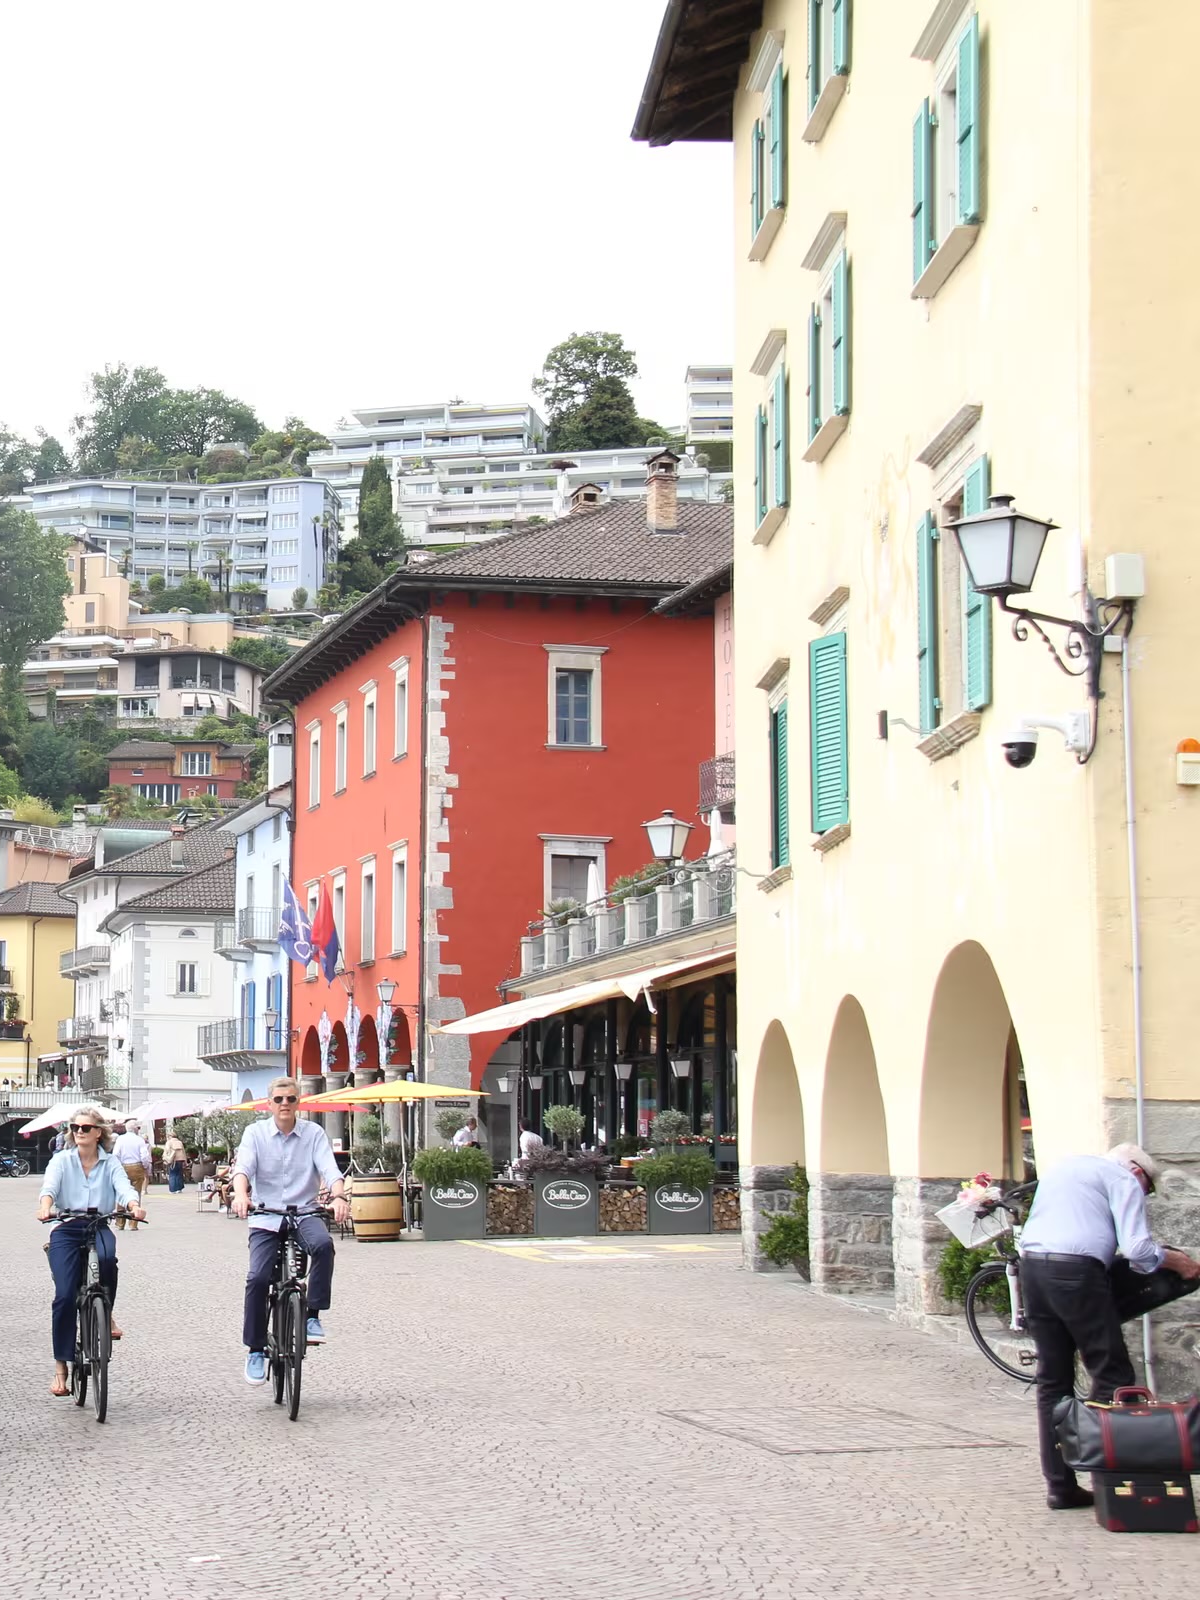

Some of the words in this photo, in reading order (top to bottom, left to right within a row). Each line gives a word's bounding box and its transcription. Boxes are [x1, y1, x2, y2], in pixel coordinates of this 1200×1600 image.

[434, 1187, 458, 1200] Bella
[457, 1188, 475, 1200] Ciao
[547, 1188, 570, 1200] Bella
[569, 1189, 587, 1201] Ciao
[659, 1191, 683, 1203] Bella
[682, 1192, 700, 1203] Ciao
